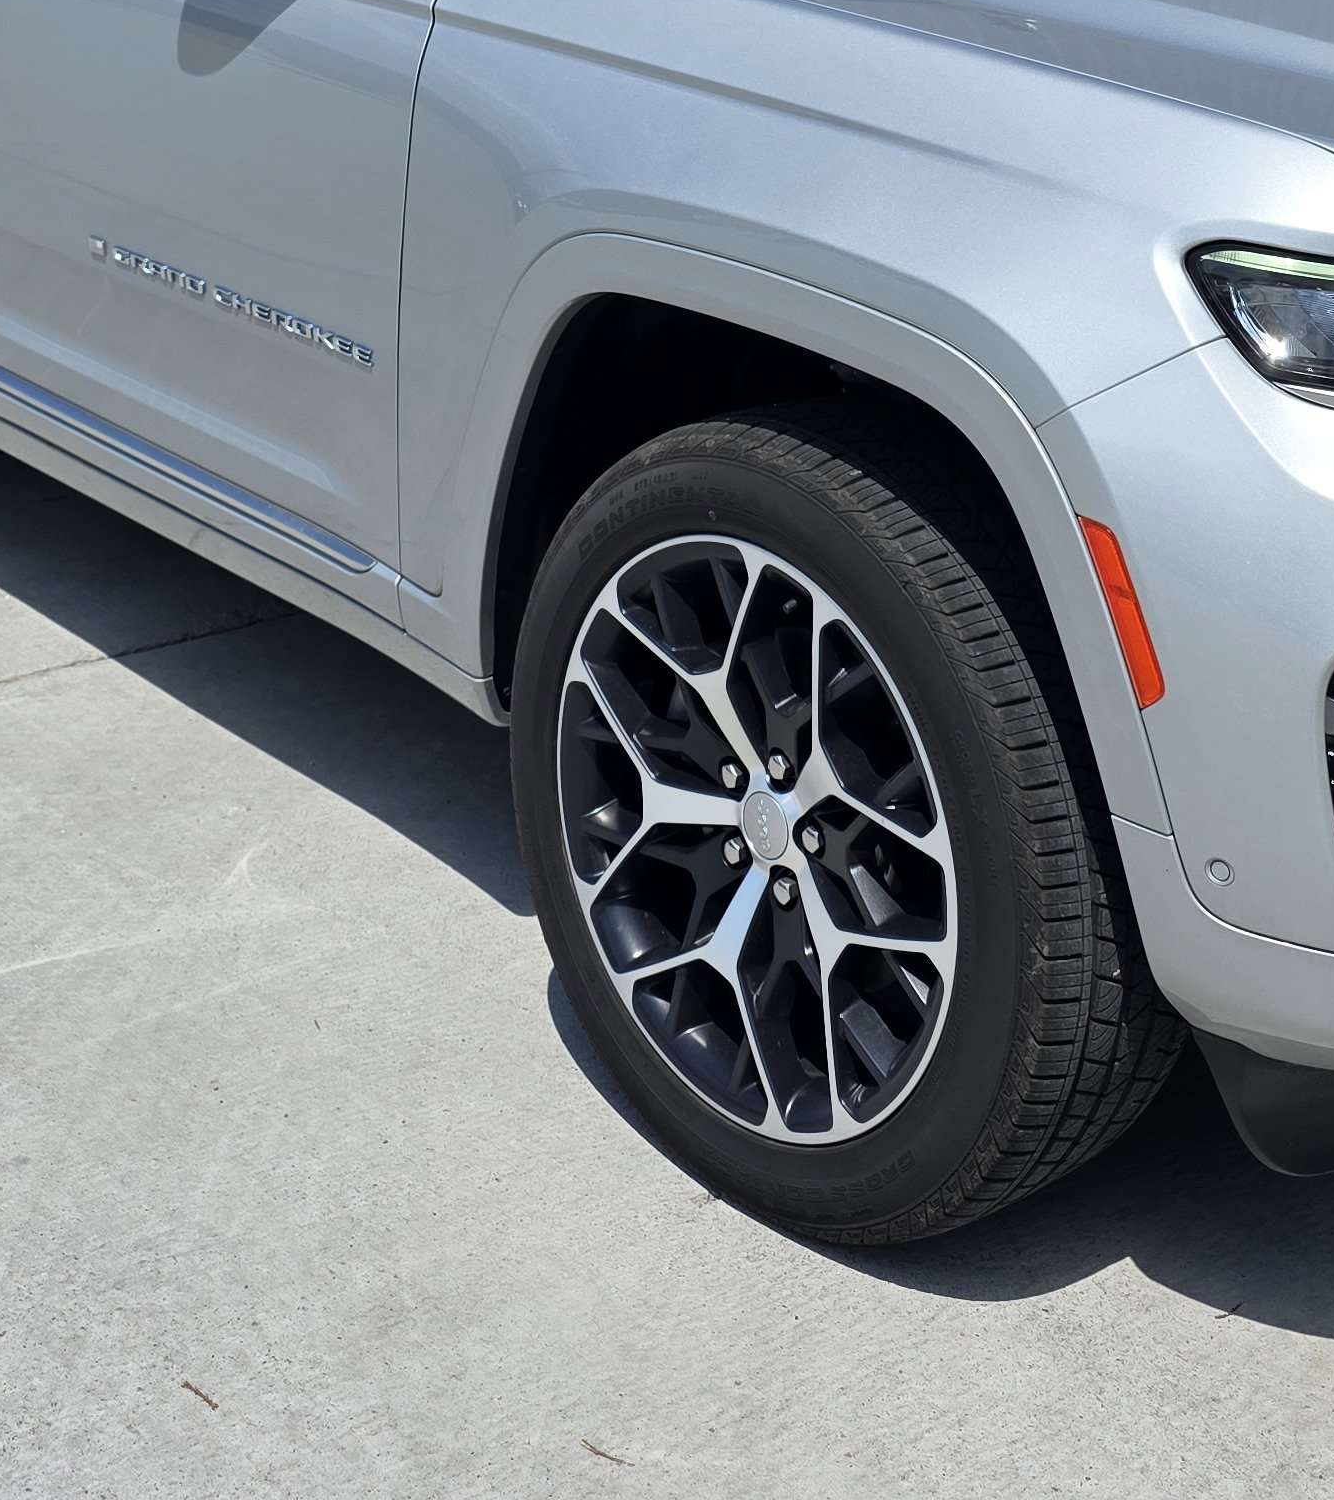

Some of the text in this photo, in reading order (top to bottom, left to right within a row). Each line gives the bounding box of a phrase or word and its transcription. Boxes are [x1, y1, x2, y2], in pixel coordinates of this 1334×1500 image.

[112, 245, 375, 368] GRAND CHEROKEE
[578, 484, 762, 561] CONTINENTAL
